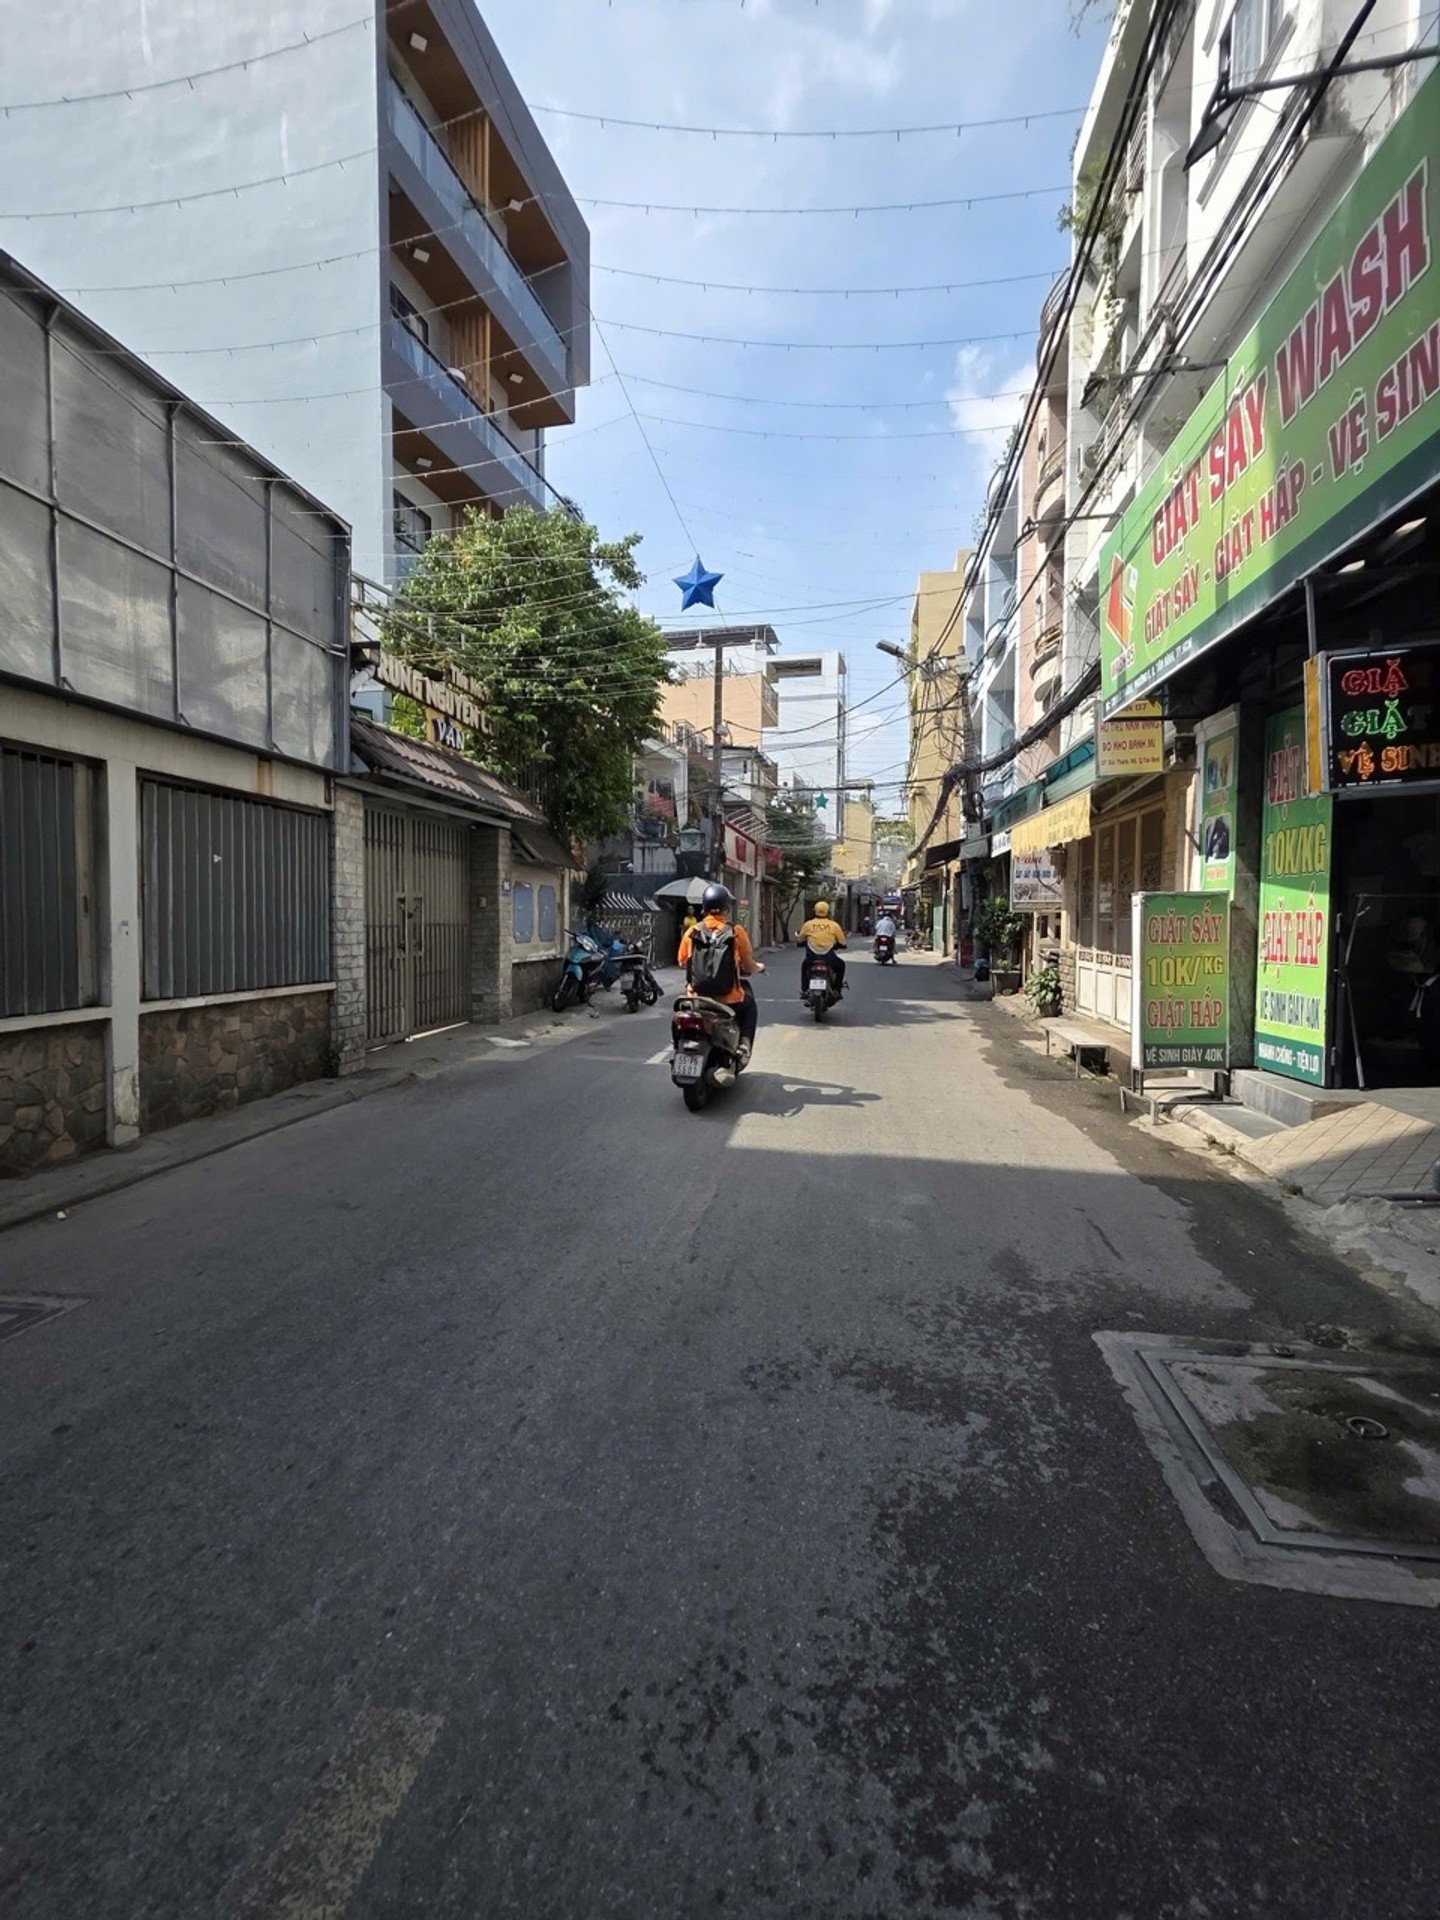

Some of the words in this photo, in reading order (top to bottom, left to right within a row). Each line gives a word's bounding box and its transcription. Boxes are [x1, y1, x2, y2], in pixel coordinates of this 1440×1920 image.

[1152, 453, 1202, 570] GIẶT
[1208, 364, 1268, 510] SẤY
[1274, 156, 1430, 430] WASH
[1144, 587, 1171, 646] GIẶT
[1173, 555, 1200, 622] SẤY
[1214, 505, 1254, 584] GIẶT
[1259, 452, 1306, 547] HẤP
[1327, 387, 1369, 482] VỆ
[1338, 741, 1375, 780] VỆ
[1147, 908, 1186, 953] GIẶT
[1191, 900, 1222, 944] SẤY
[1294, 880, 1323, 967] HẤP
[1147, 993, 1186, 1039] GIẶT
[1189, 986, 1223, 1029] HẤP
[1145, 1045, 1157, 1066] VỆ
[1159, 1048, 1180, 1062] SINH
[1181, 1045, 1203, 1063] GIÀY
[1204, 1048, 1223, 1062] 40K
